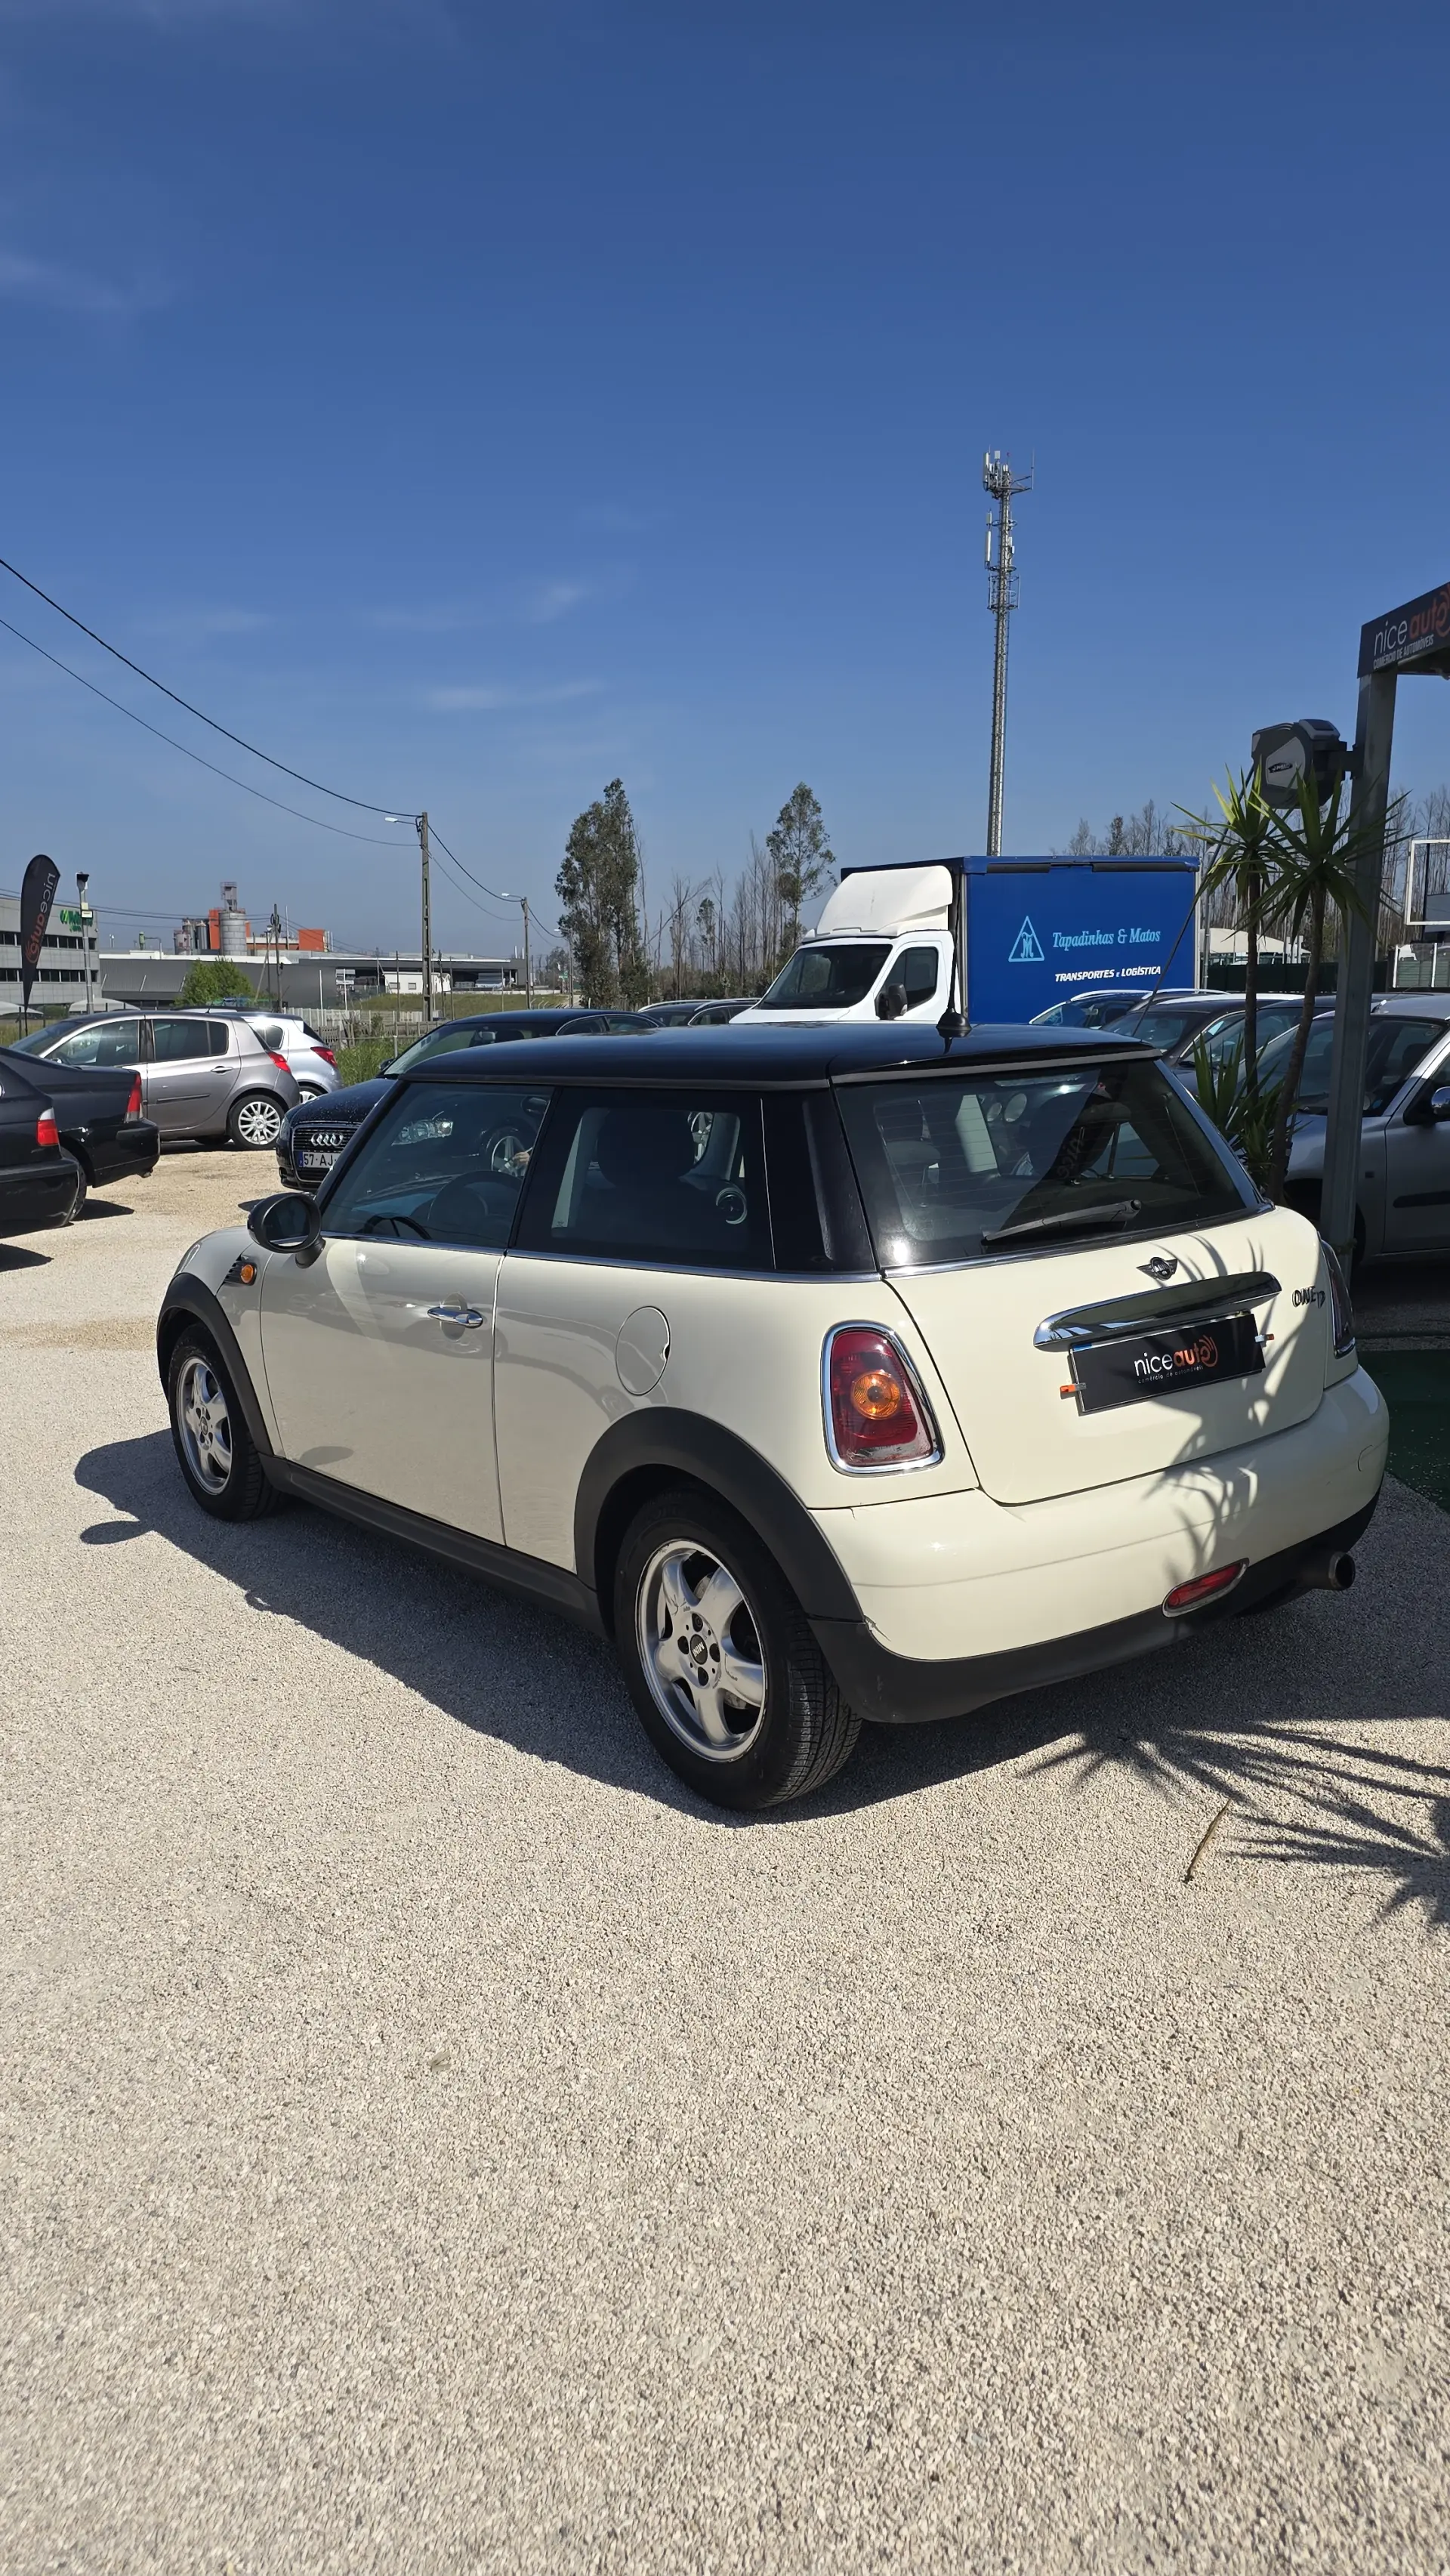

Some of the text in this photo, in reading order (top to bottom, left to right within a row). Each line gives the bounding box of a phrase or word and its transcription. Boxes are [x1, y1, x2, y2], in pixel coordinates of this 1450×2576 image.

[1053, 928, 1161, 951] Tapadinhas & Matos
[1055, 969, 1115, 982] TRANSPORTES
[1121, 965, 1161, 977] LOGÍSTICA
[692, 1642, 705, 1657] MINI
